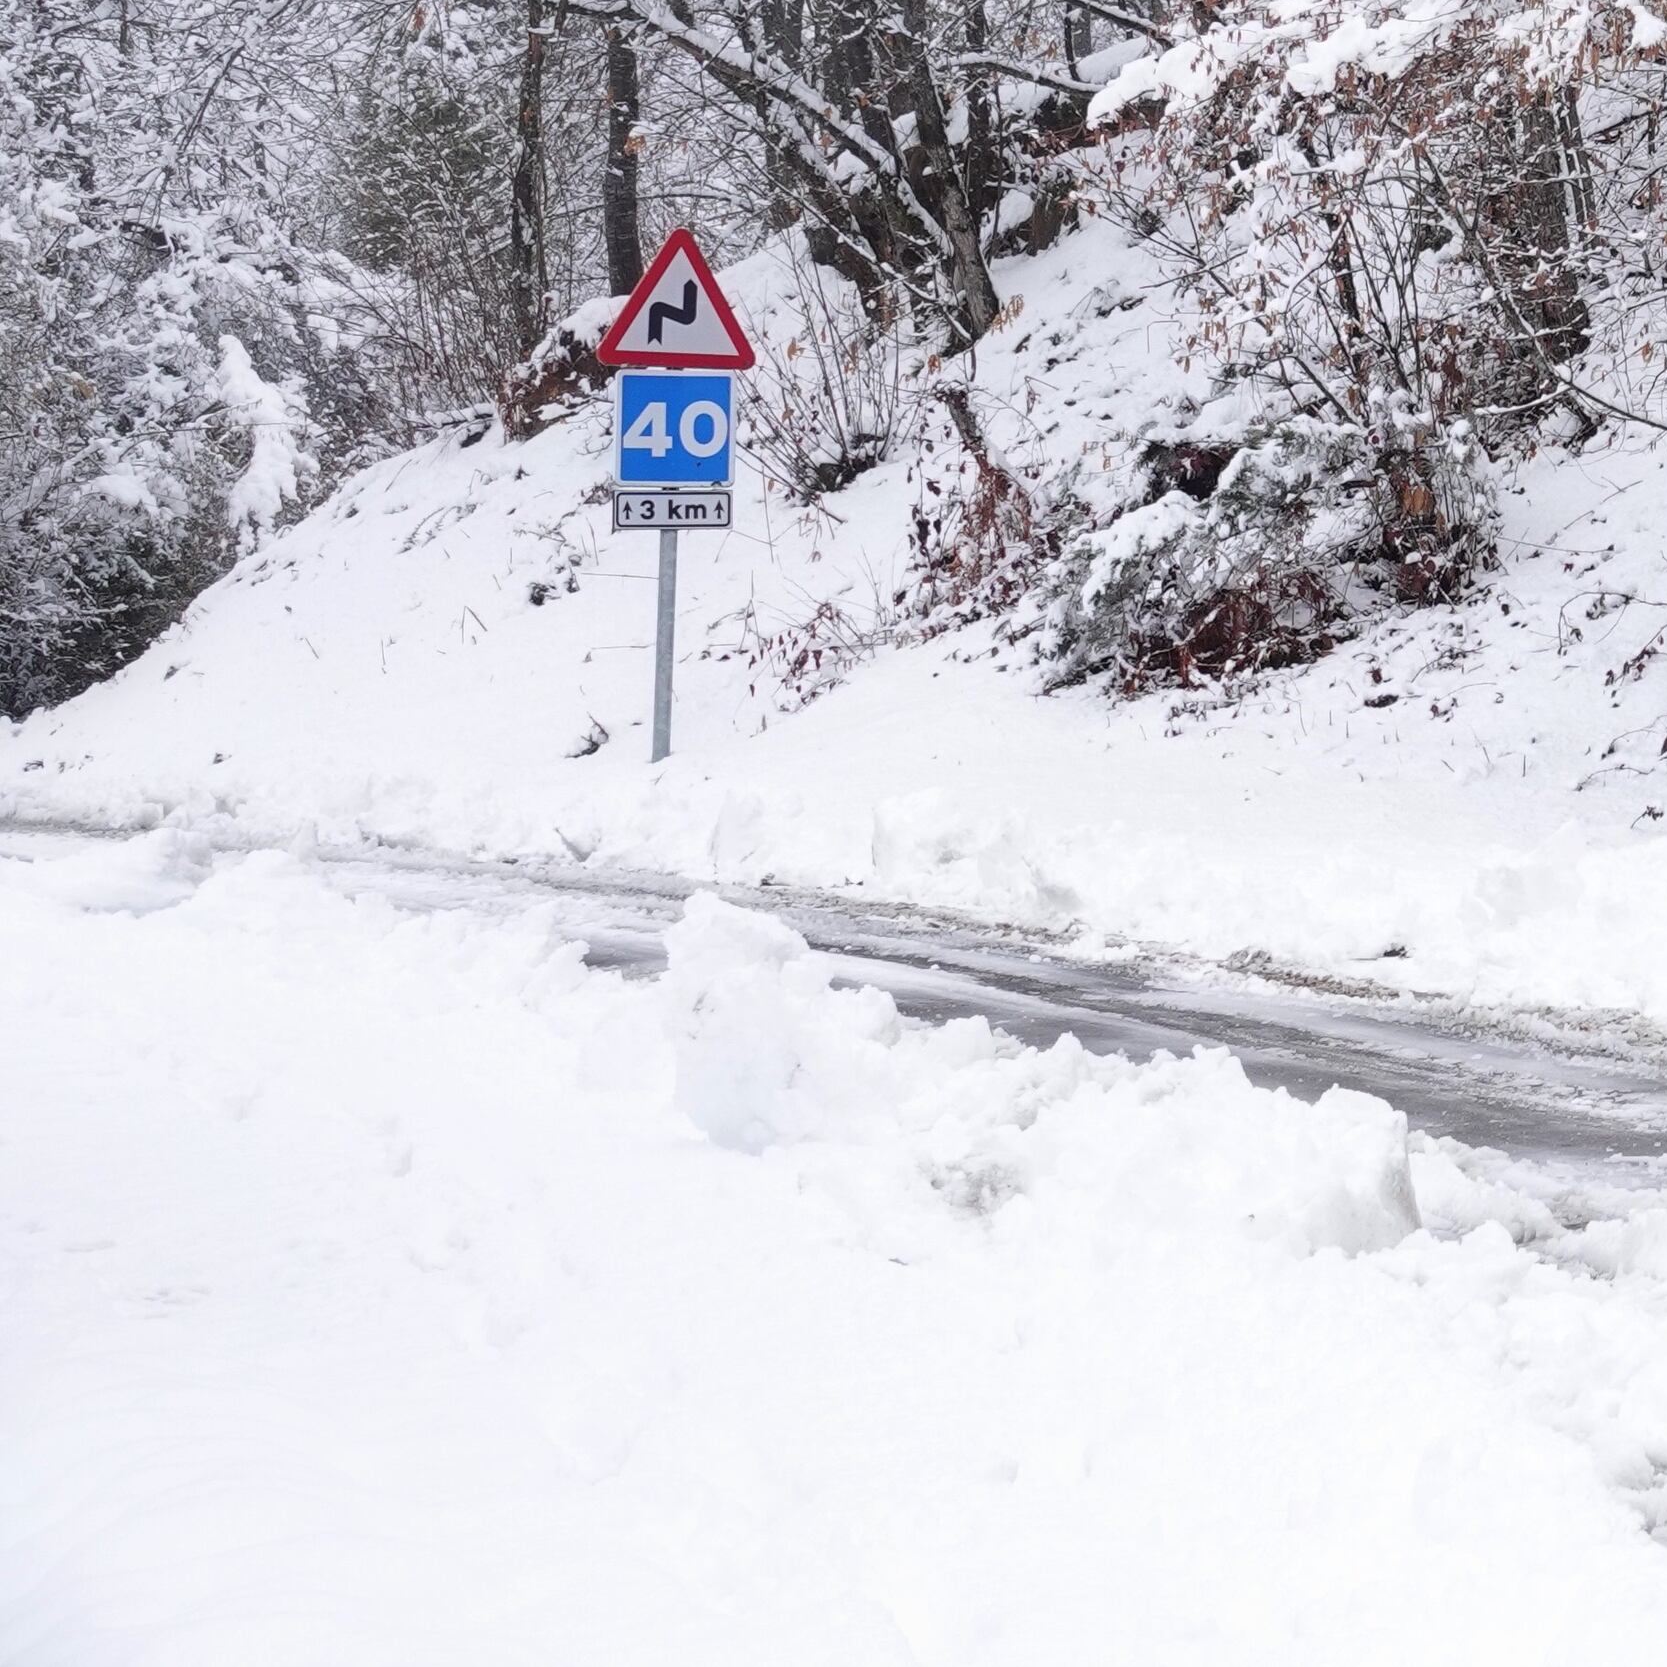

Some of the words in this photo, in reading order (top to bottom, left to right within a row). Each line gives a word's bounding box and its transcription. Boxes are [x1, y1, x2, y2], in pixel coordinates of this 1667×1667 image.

[623, 400, 728, 458] 40
[640, 500, 655, 520] 3
[668, 499, 707, 519] km
